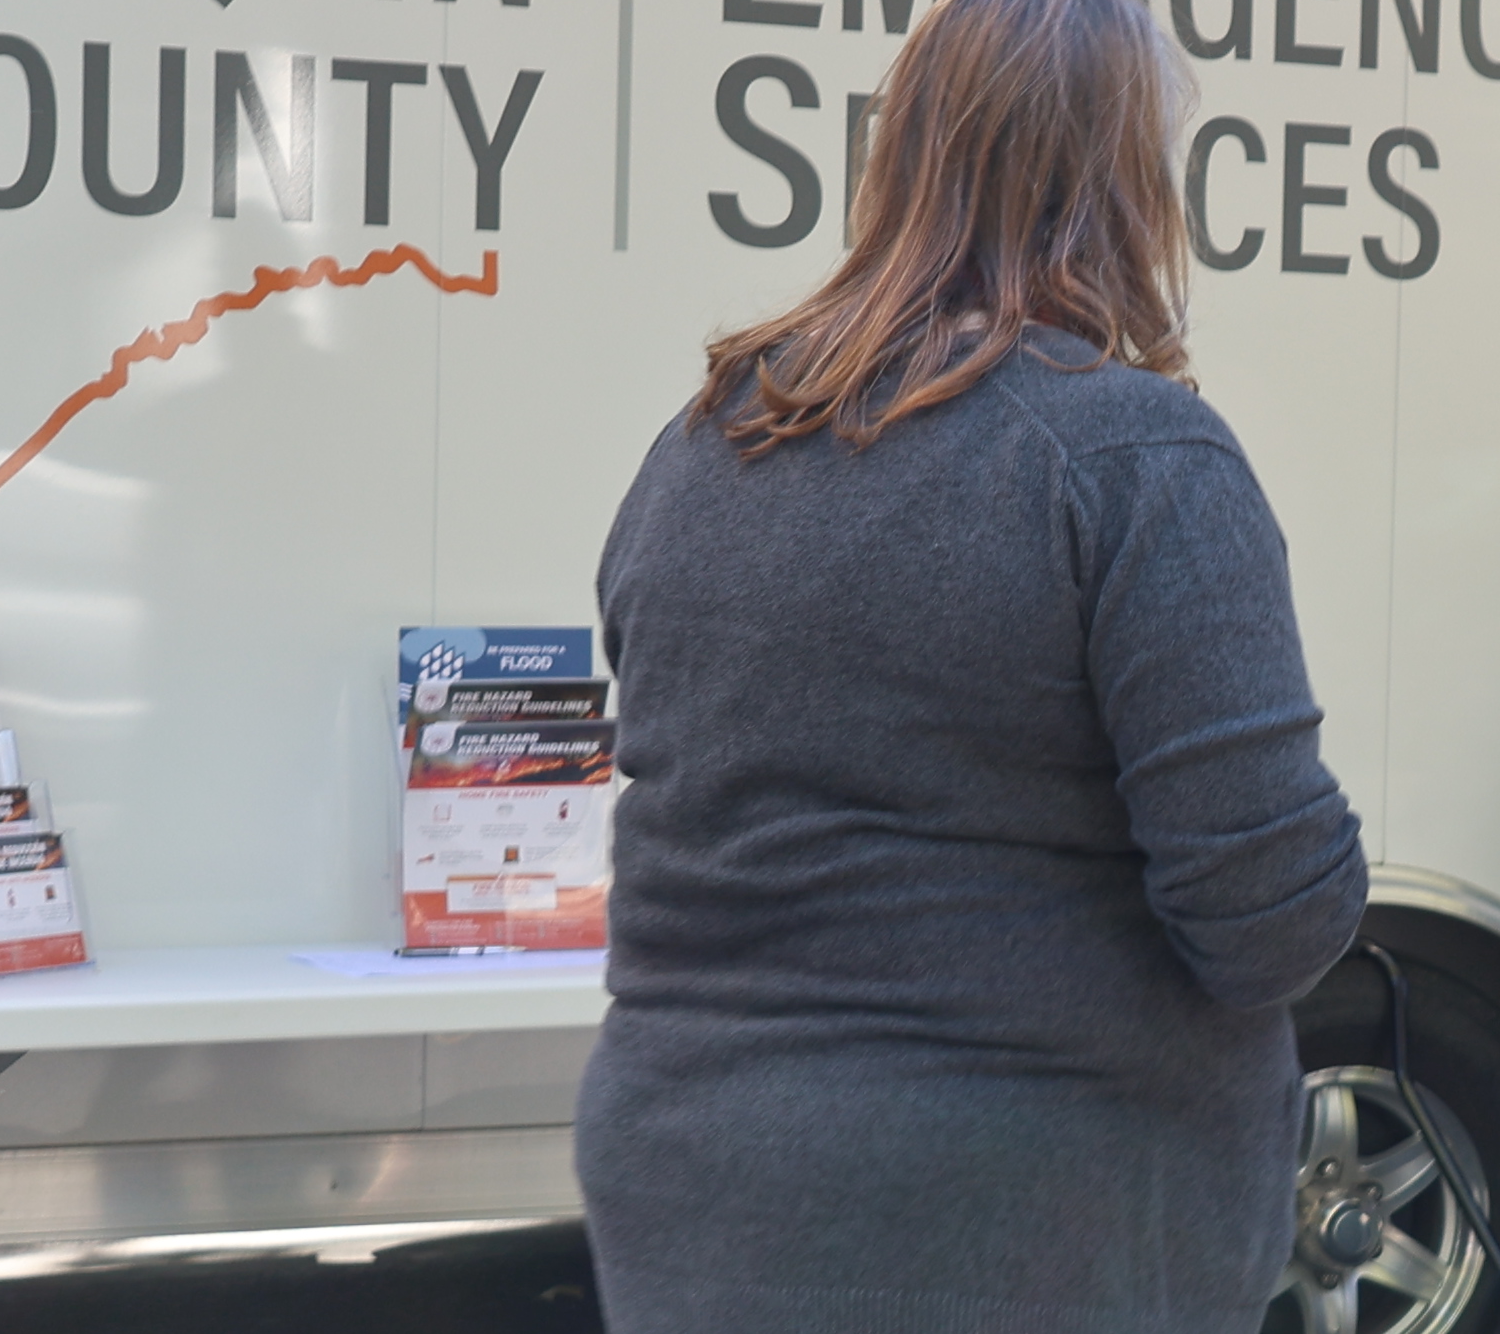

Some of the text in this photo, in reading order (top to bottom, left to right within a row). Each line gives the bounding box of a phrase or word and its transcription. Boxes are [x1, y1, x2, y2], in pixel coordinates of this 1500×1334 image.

[707, 53, 1441, 281] SCES
[500, 655, 553, 672] FLOOD
[452, 690, 533, 702] FIRE HAZARD
[450, 700, 593, 713] REDUCTION GUIDELINES
[458, 733, 540, 745] FIRE HAZARD
[456, 741, 600, 755] REDUCTION GUIDELINES
